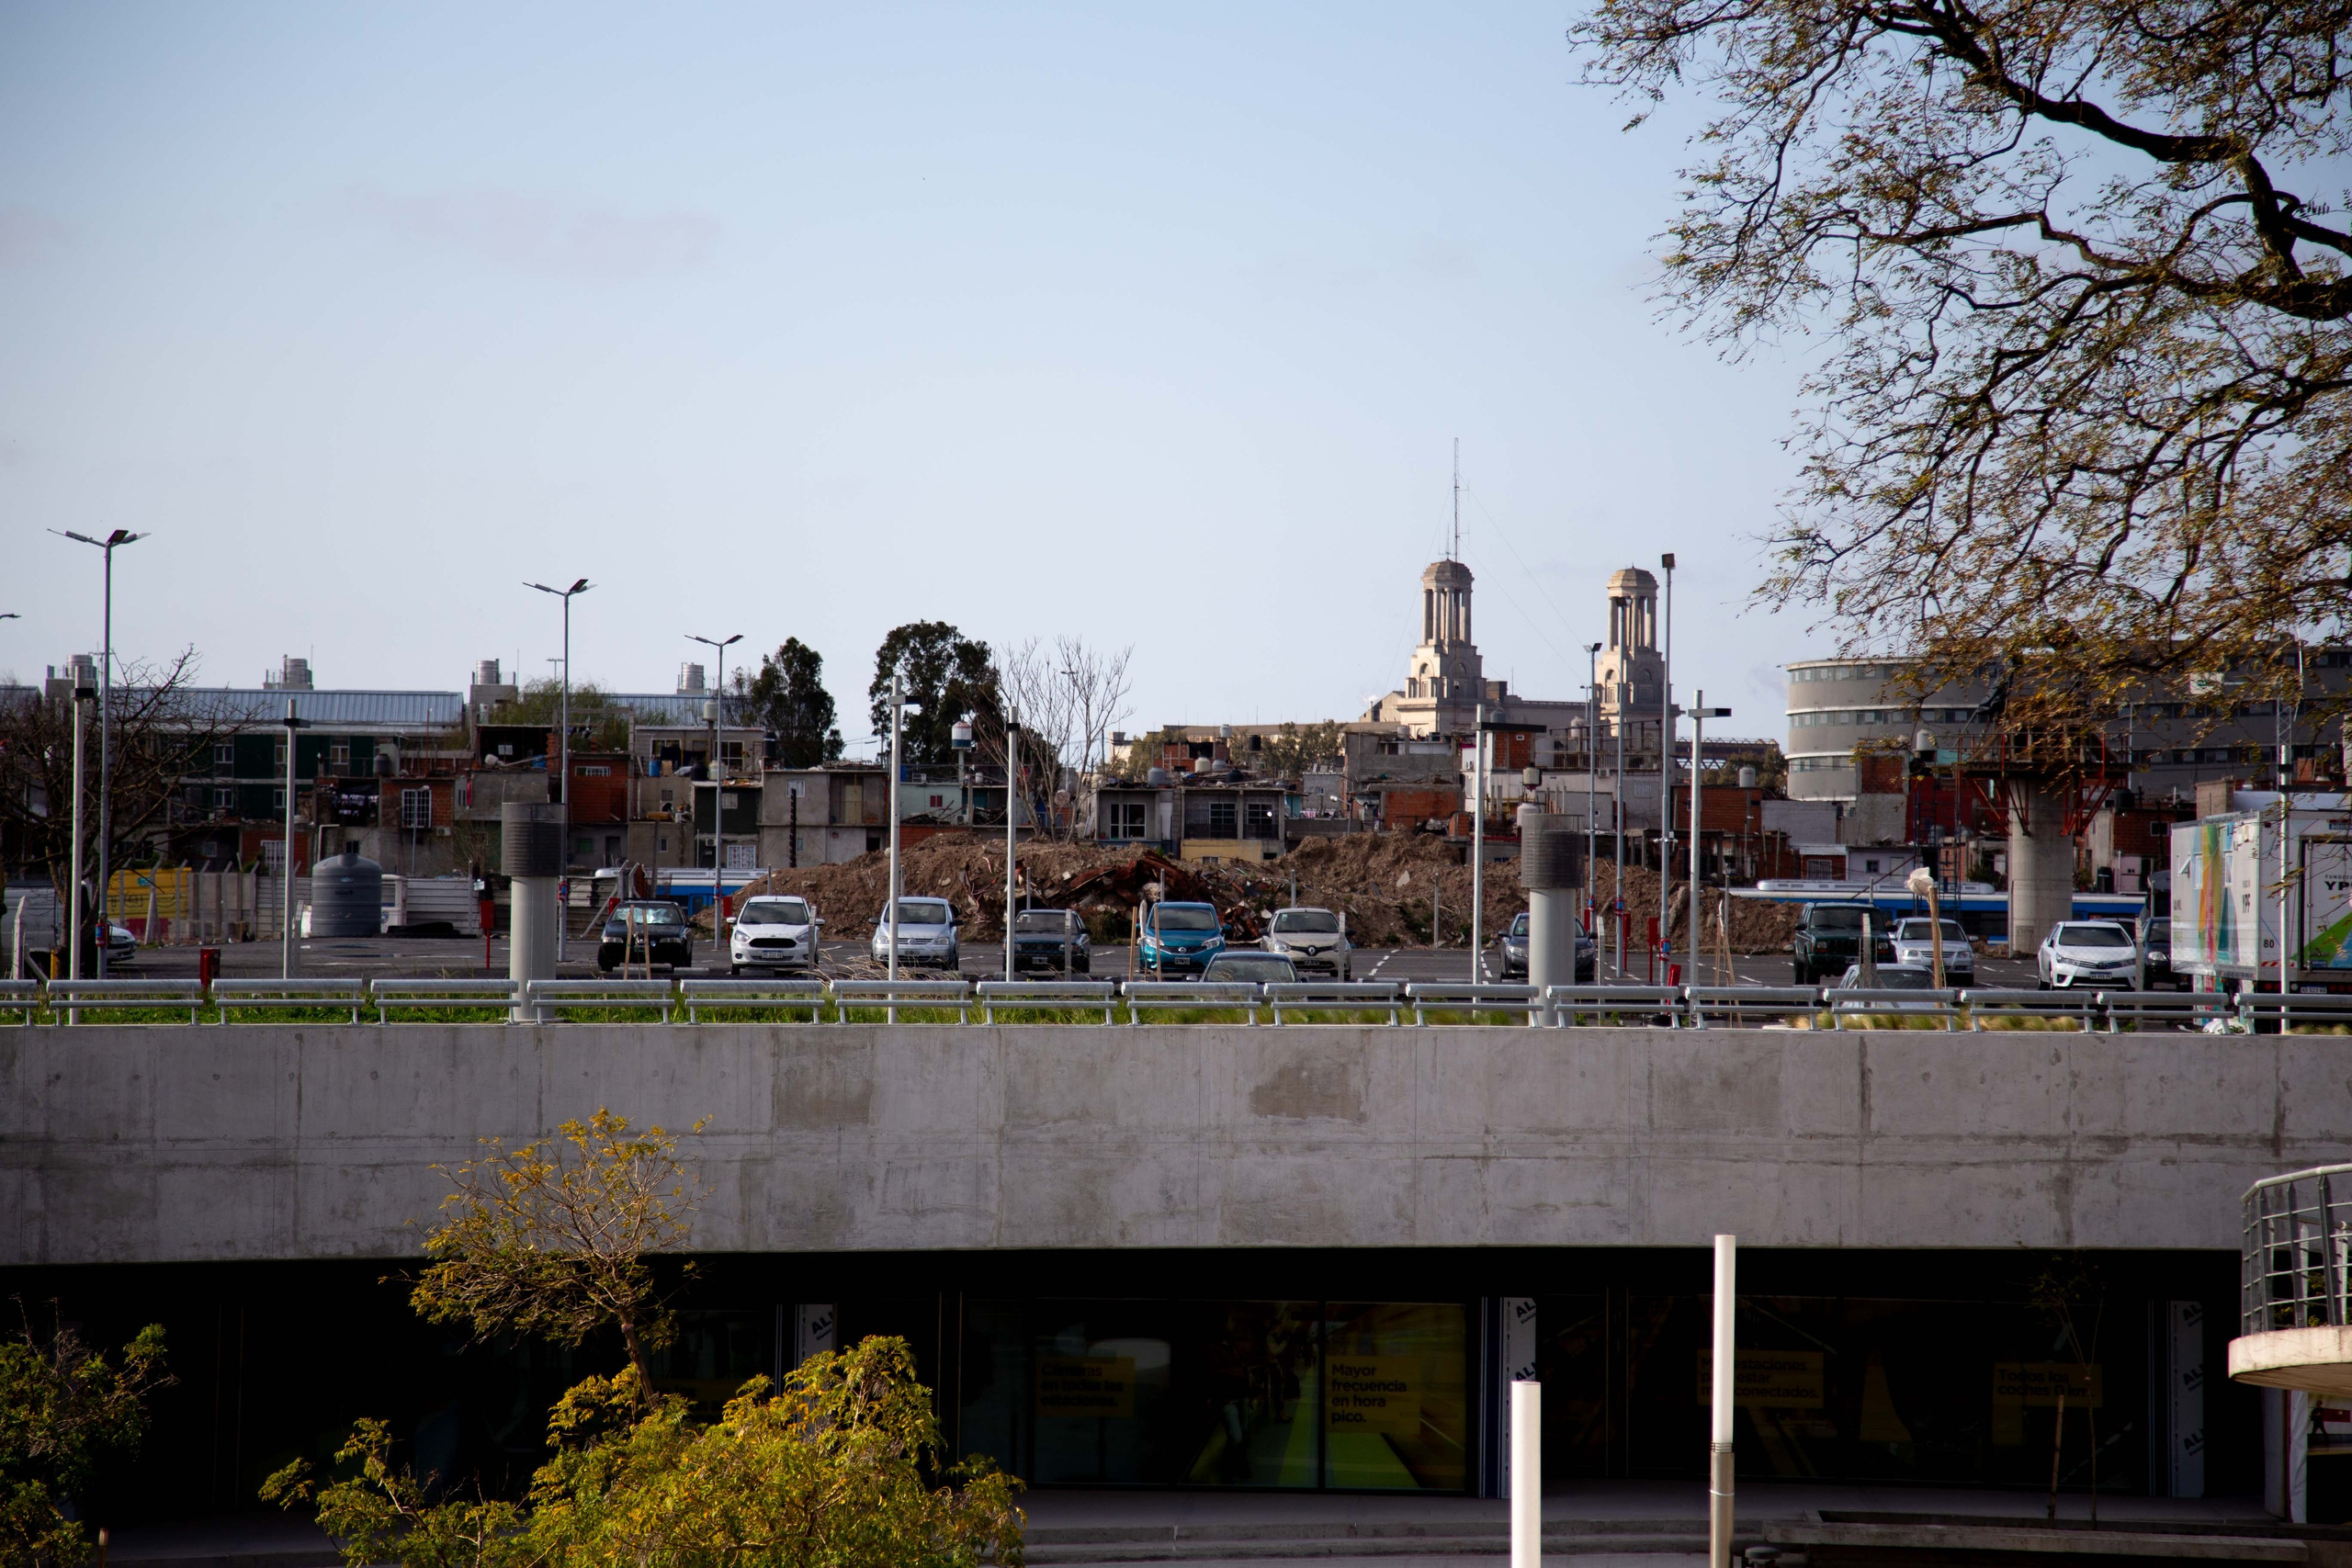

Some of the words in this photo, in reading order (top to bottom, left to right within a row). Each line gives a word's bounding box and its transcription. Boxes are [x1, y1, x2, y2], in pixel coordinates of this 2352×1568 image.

[2324, 881, 2352, 891] YP
[2263, 939, 2275, 949] 80
[1331, 1364, 1377, 1379] Mayor
[1735, 1359, 1807, 1371] estaciones
[1736, 1372, 1771, 1383] estar
[1998, 1369, 2045, 1382] Todos
[2049, 1371, 2069, 1383] los
[1062, 1380, 1101, 1392] todas
[1104, 1380, 1124, 1392] las
[1331, 1379, 1407, 1393] frecuencia
[1735, 1385, 1819, 1398] conectados.
[1998, 1383, 2050, 1396] coches
[2054, 1384, 2064, 1395] 0
[1041, 1395, 1118, 1407] estaciones.
[1331, 1396, 1350, 1407] en
[1353, 1394, 1386, 1407] hora
[1331, 1410, 1367, 1425] pico.
